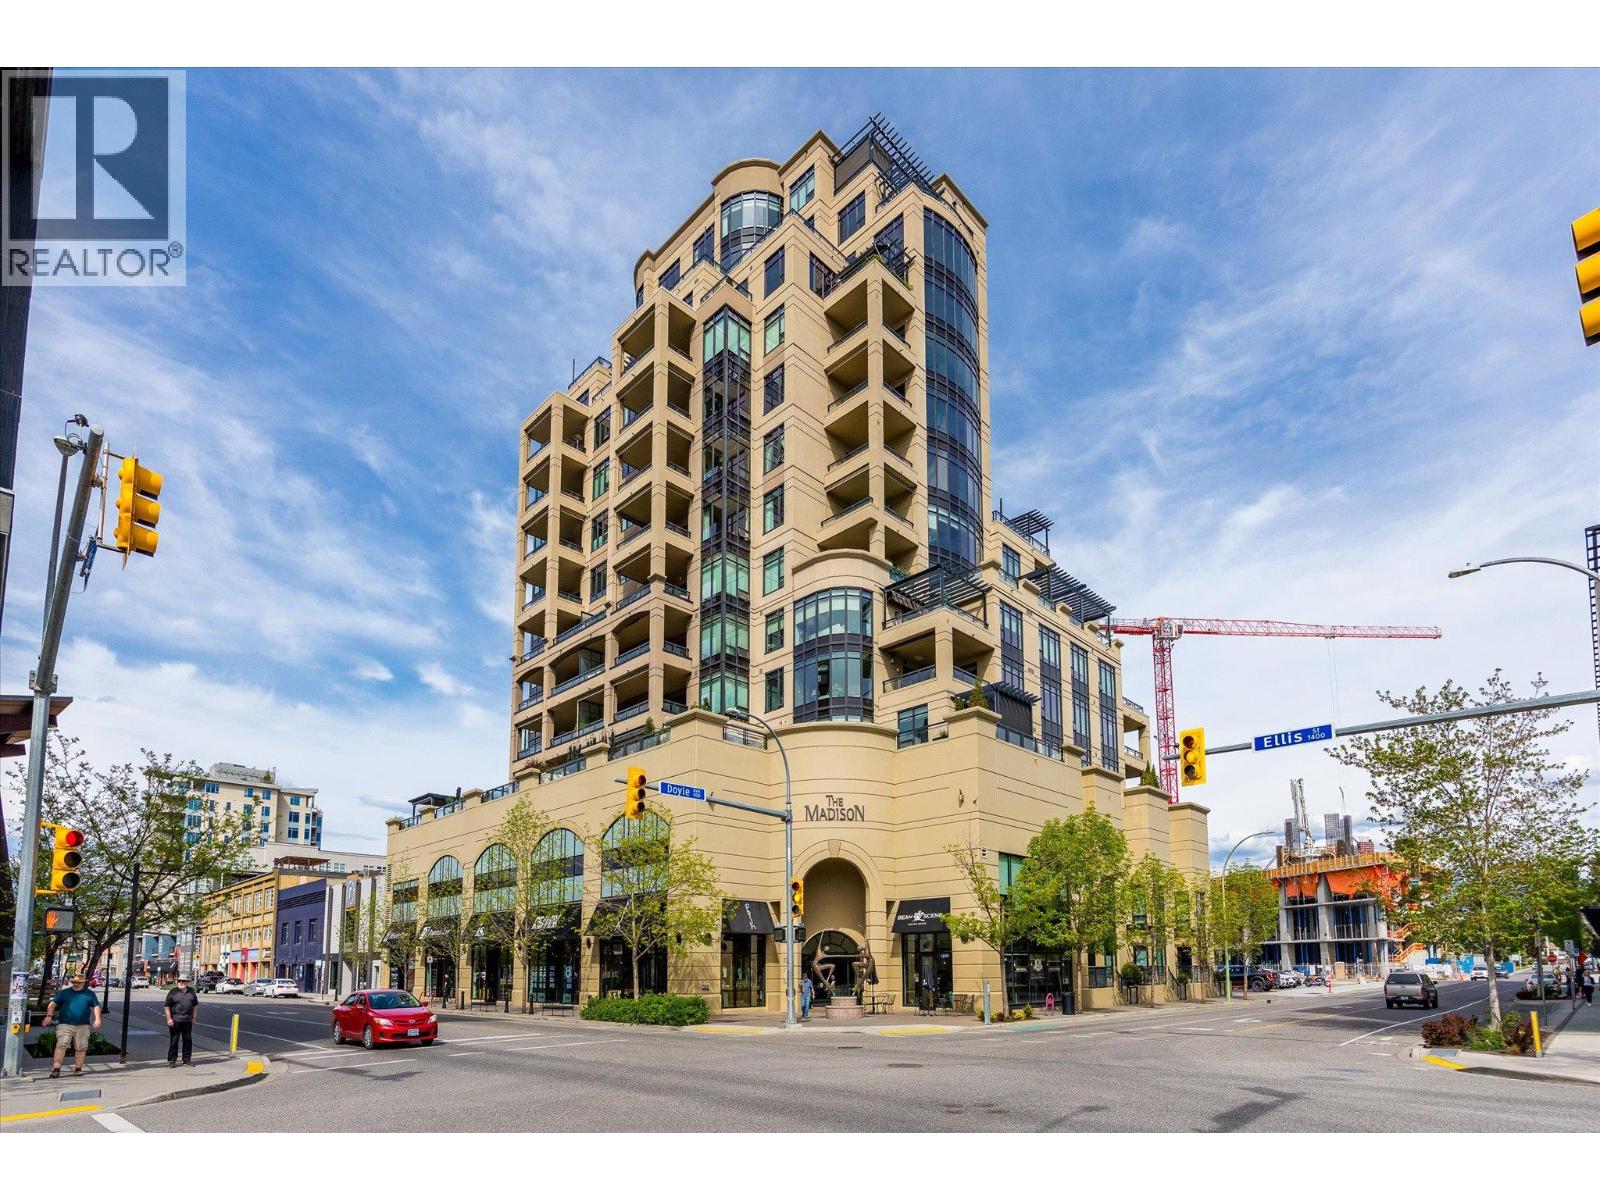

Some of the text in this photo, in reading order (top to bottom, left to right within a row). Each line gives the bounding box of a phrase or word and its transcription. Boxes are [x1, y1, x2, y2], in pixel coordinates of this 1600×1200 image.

[1263, 732, 1303, 748] Ellis
[1307, 732, 1326, 740] 1400
[667, 784, 690, 797] Doyle
[826, 794, 844, 807] THE
[804, 804, 865, 822] MADISON
